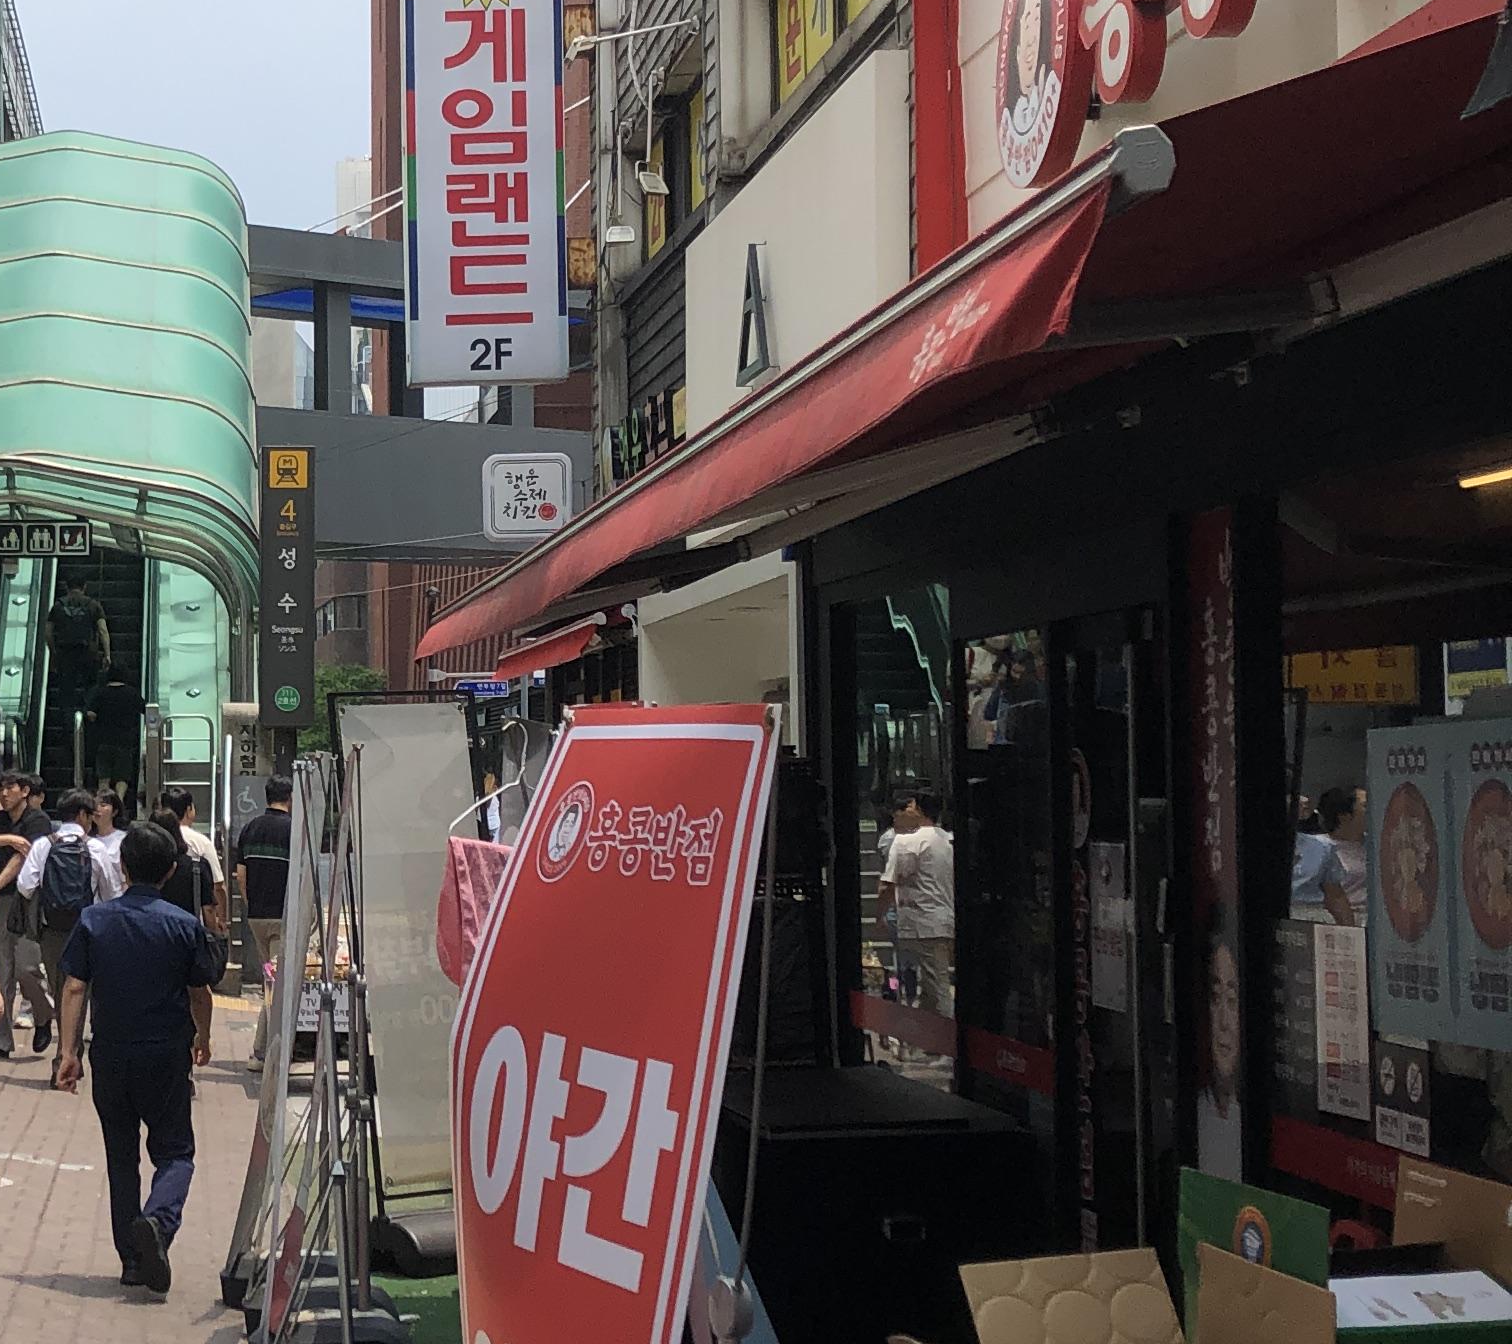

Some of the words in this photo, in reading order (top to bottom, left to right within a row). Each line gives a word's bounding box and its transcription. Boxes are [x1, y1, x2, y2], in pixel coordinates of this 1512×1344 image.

[441, 8, 534, 326] 게임랜드
[469, 337, 513, 371] 2F
[504, 468, 539, 490] 행운
[513, 488, 547, 506] 수제
[280, 499, 297, 522] 4
[502, 502, 538, 521] 치킨
[271, 625, 304, 635] Seongsu
[587, 799, 724, 886] 홍콩반점
[470, 1025, 678, 1293] 야간
